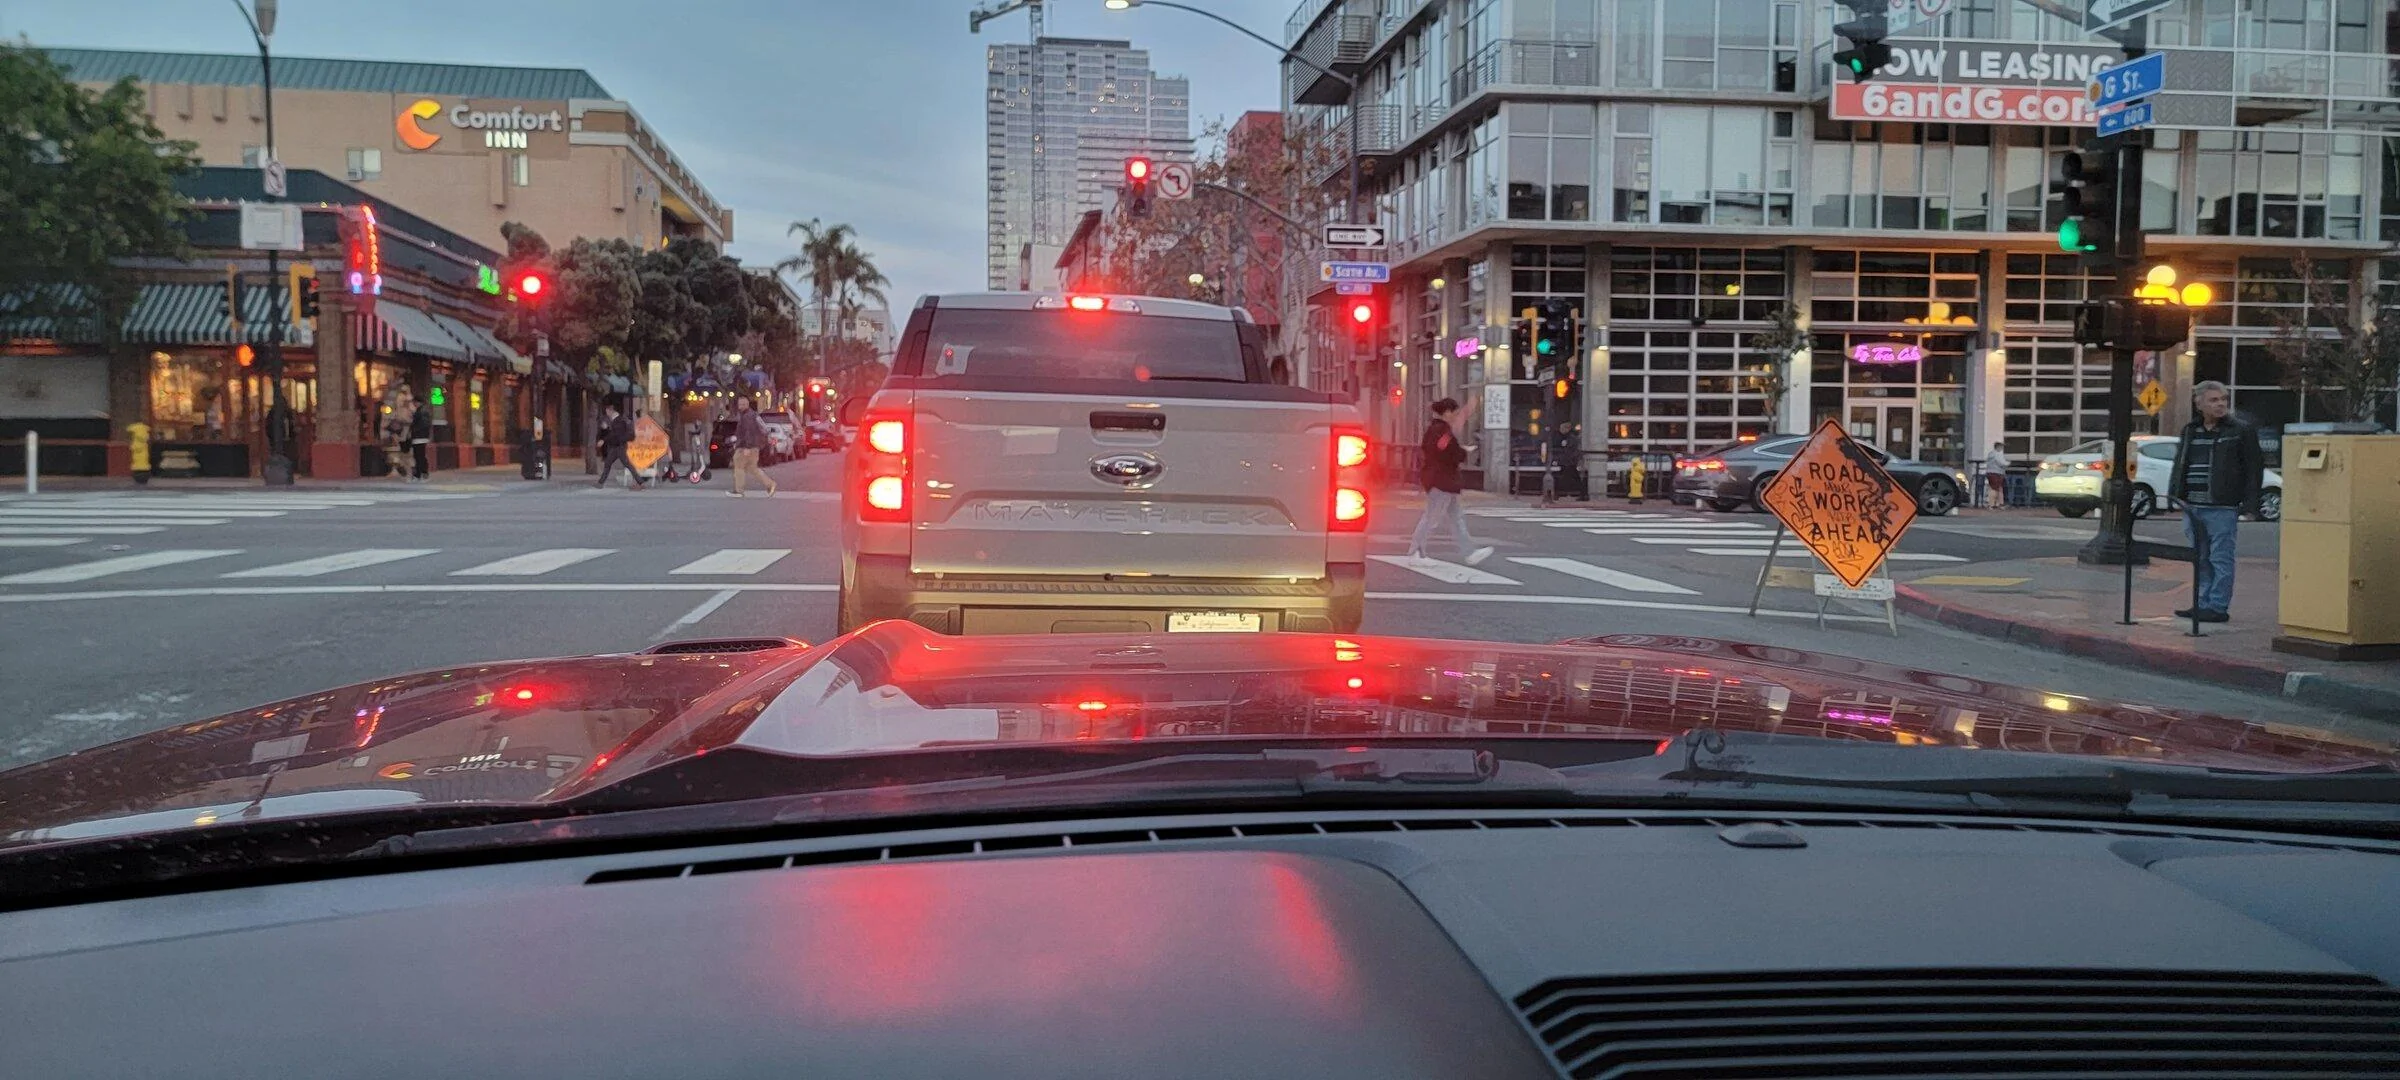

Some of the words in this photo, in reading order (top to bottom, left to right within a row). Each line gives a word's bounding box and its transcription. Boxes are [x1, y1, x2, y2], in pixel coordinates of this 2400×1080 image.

[1872, 48, 1947, 77] OW
[2104, 75, 2117, 98] G
[451, 104, 562, 131] Comfort
[2124, 107, 2145, 126] 600
[485, 130, 528, 149] INN
[1809, 462, 1865, 483] ROAD
[974, 503, 1269, 525] MAVERICK
[1812, 491, 1871, 515] WORK
[1811, 523, 1886, 544] AHEAD
